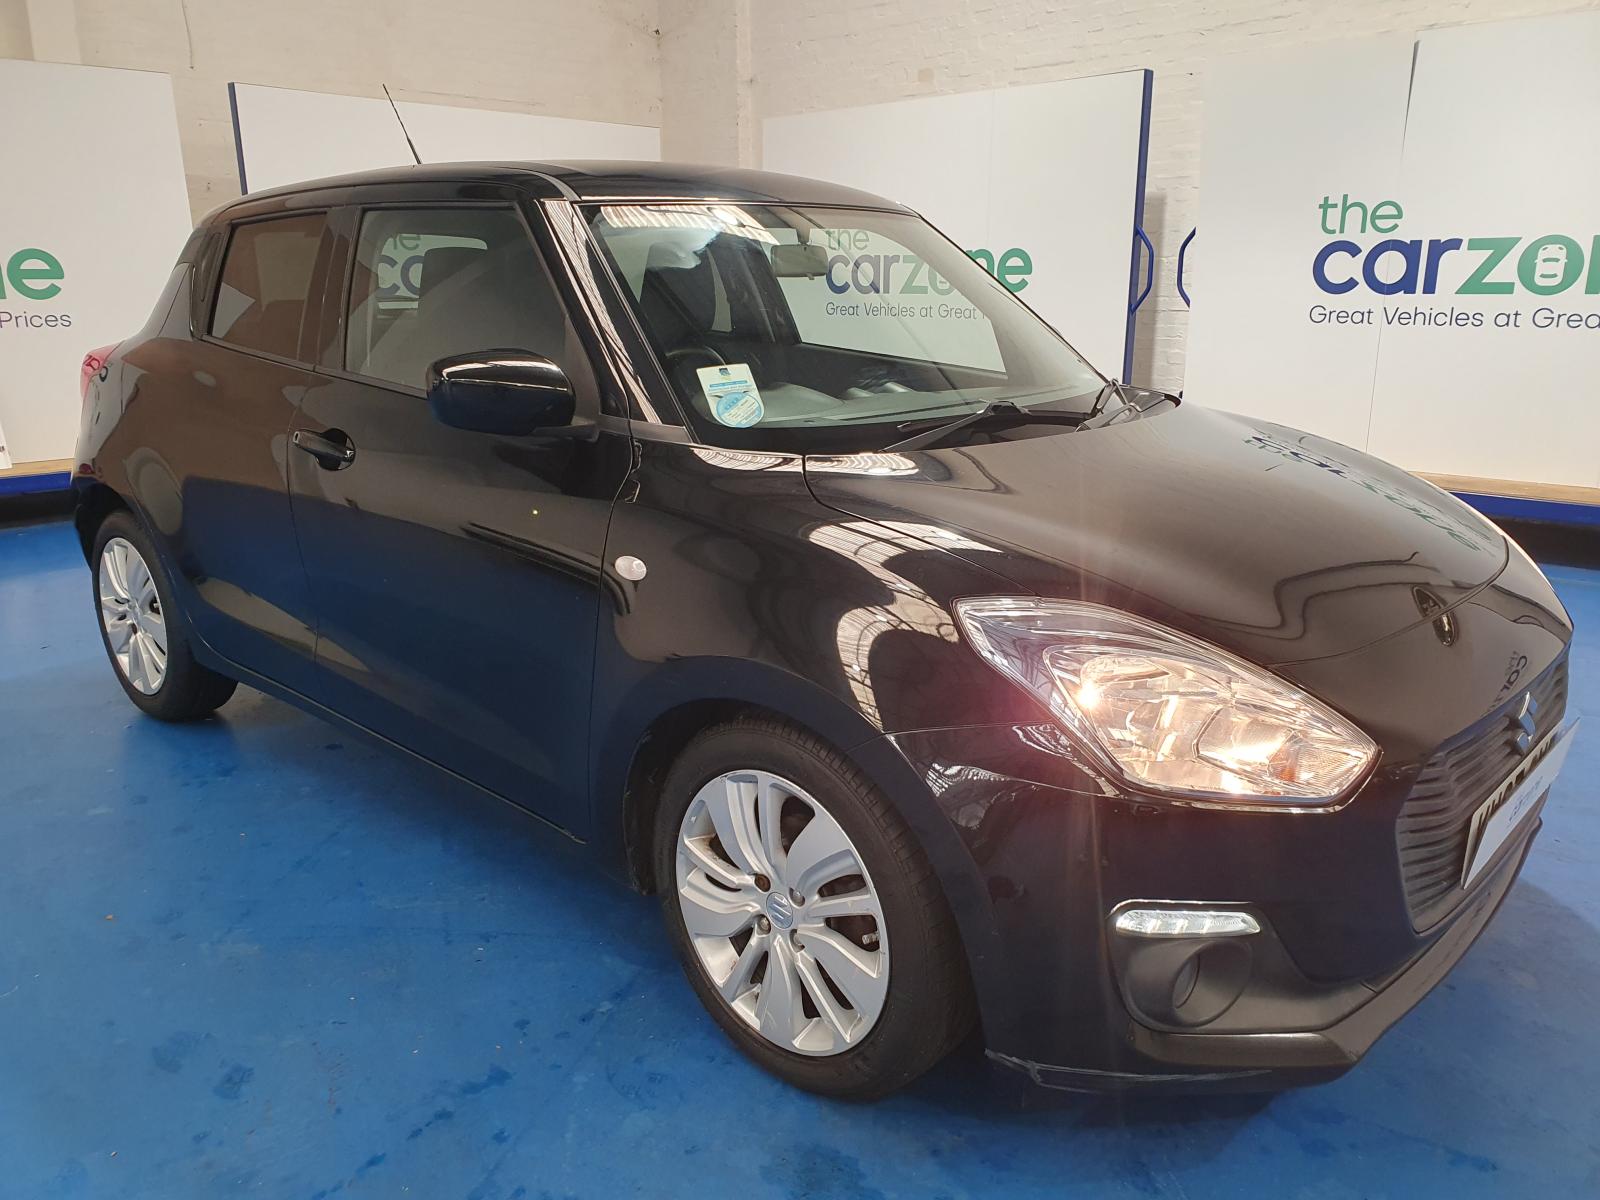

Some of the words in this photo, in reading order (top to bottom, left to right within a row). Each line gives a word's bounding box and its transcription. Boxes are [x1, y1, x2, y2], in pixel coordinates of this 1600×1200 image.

[1318, 193, 1404, 235] the
[1312, 234, 1600, 296] carzo
[0, 310, 72, 328] Prices
[825, 301, 860, 317] Great
[864, 302, 915, 318] Vehicles
[919, 304, 934, 318] at
[938, 303, 978, 320] Great
[1309, 304, 1374, 325] Great
[1383, 306, 1484, 328] Vehicles
[1494, 308, 1522, 328] at
